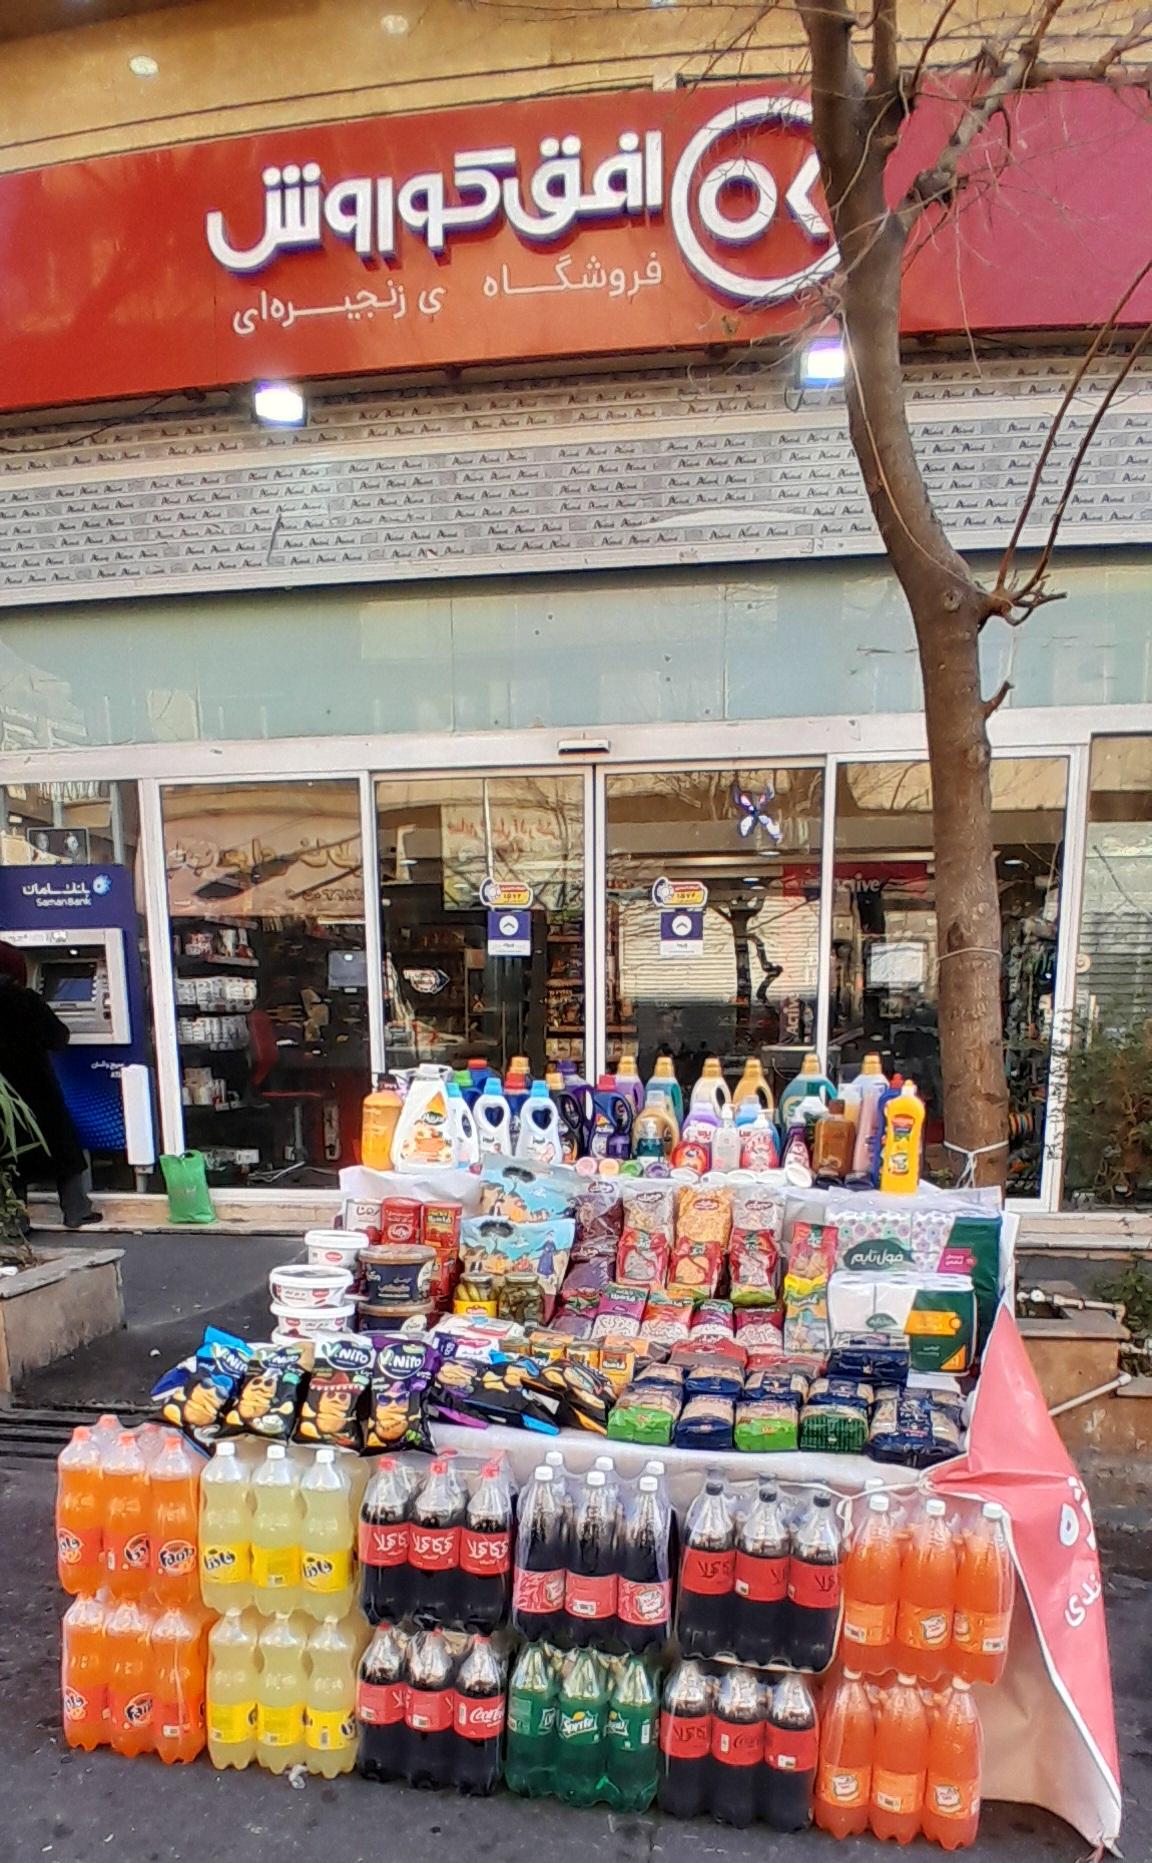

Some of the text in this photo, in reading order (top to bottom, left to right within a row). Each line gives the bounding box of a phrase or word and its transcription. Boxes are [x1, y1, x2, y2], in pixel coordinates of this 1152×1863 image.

[207, 131, 662, 271] افق کوروش
[483, 256, 662, 298] فروشگاه
